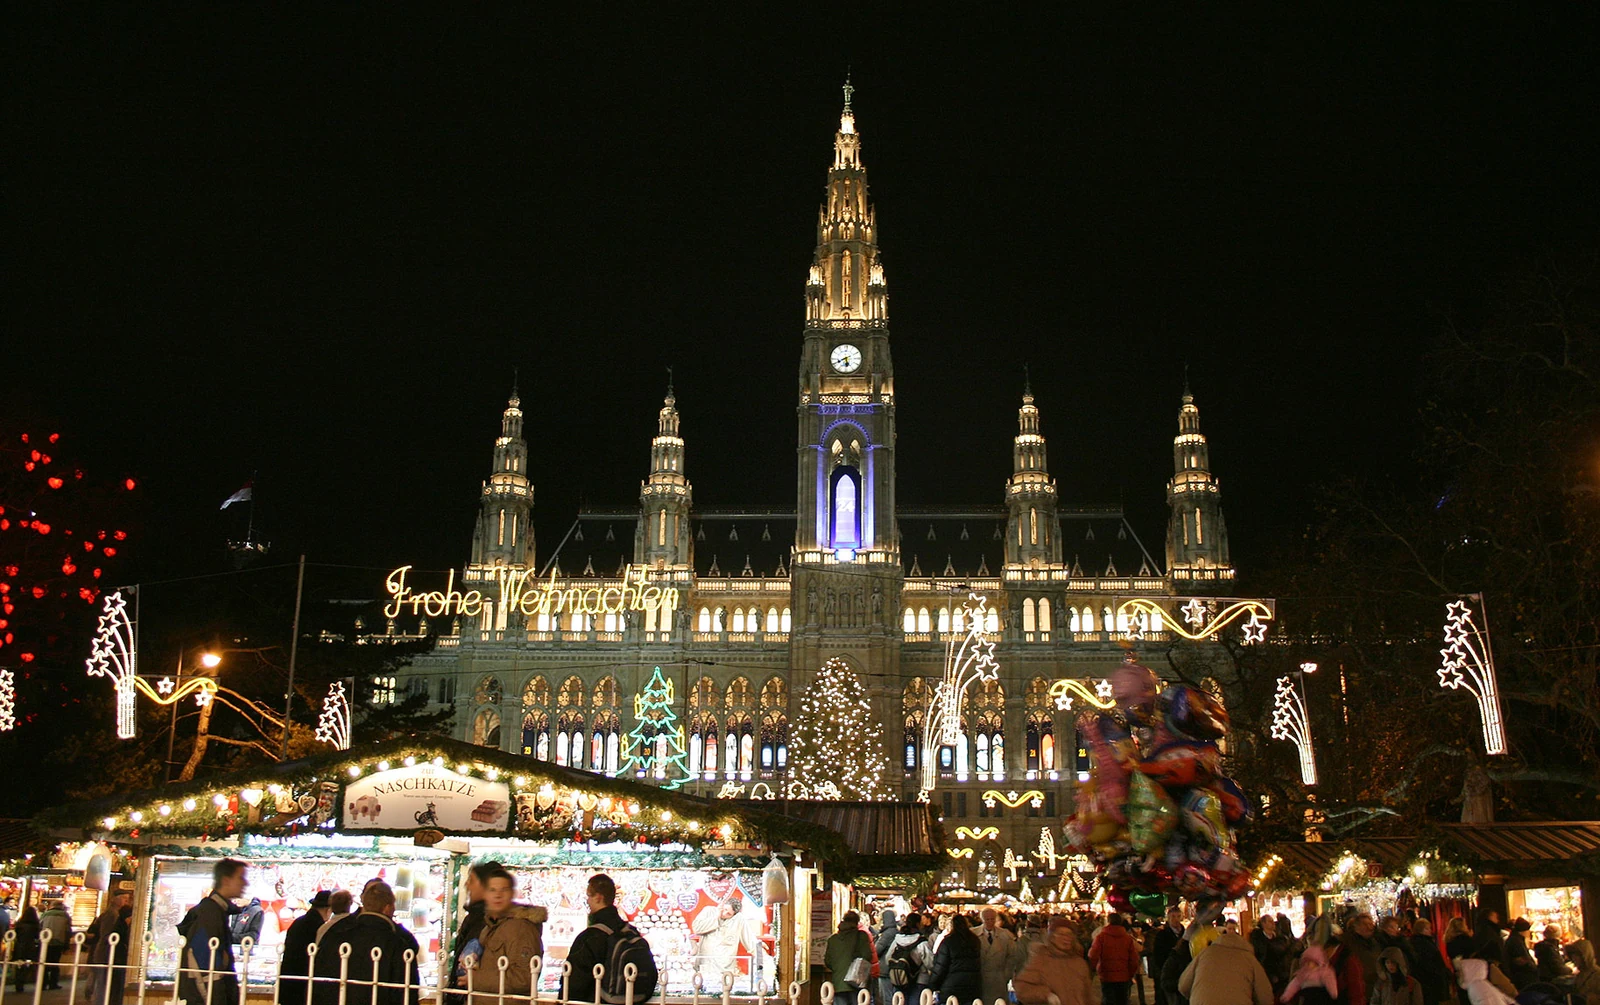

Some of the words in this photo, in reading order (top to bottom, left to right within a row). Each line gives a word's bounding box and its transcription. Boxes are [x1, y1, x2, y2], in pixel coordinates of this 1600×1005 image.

[384, 565, 483, 618] Frohe
[493, 563, 679, 615] Weihnachten
[373, 777, 476, 797] NASCHKATZE
[419, 831, 436, 845] 75
